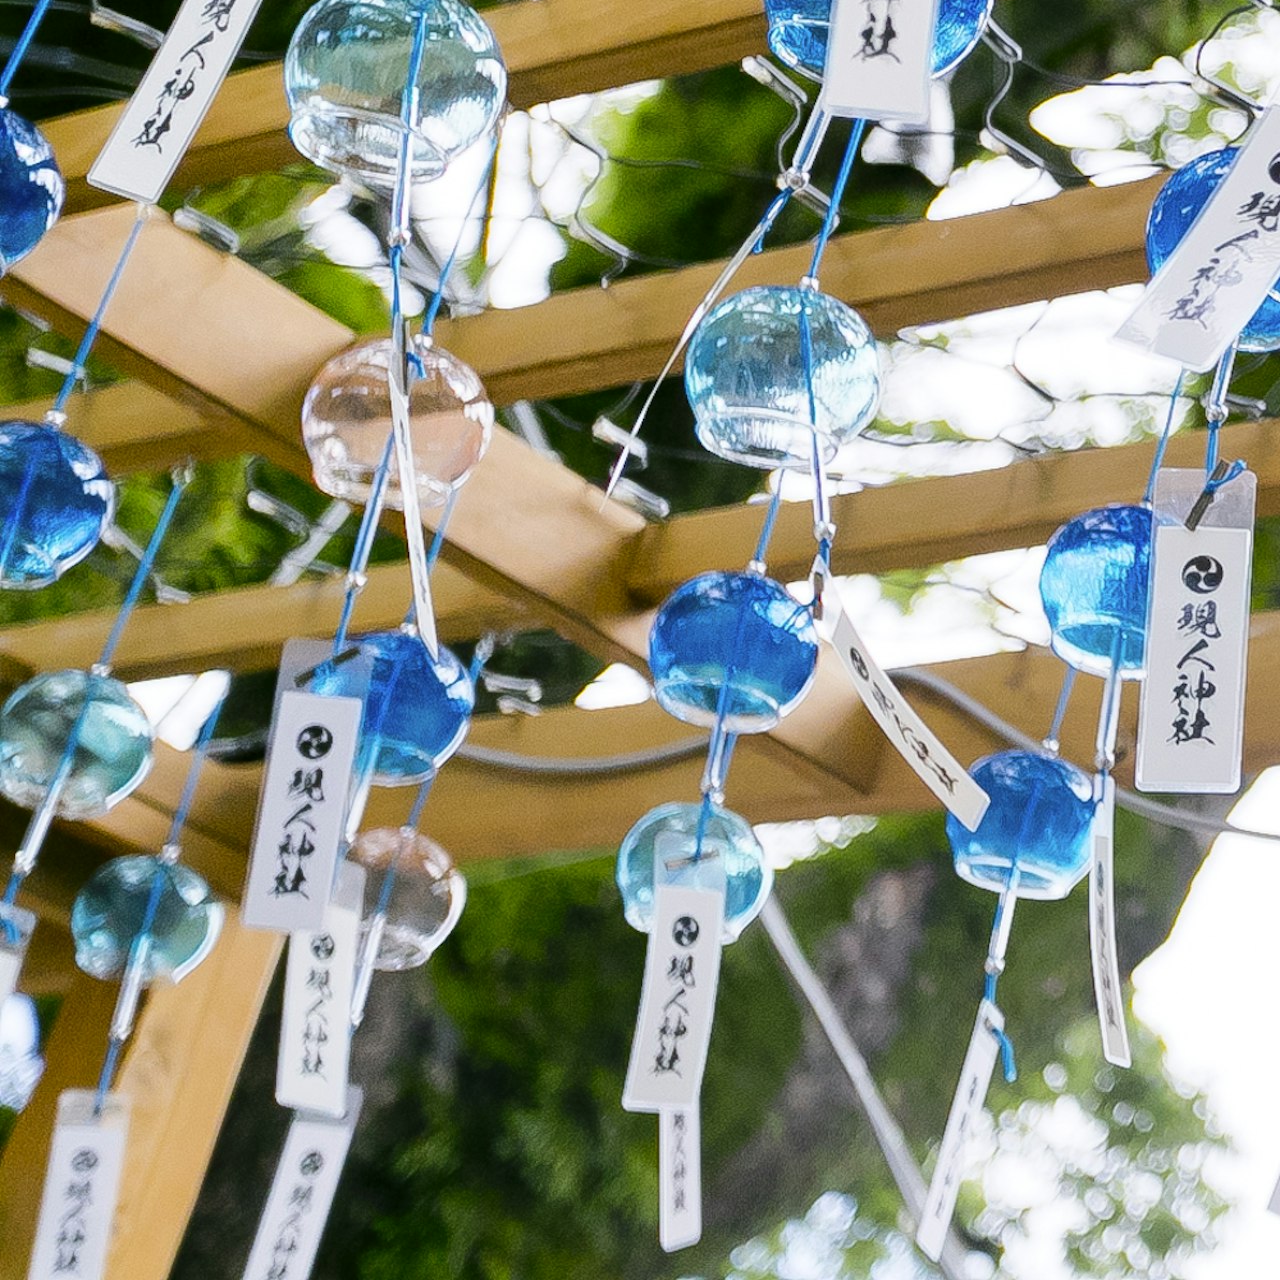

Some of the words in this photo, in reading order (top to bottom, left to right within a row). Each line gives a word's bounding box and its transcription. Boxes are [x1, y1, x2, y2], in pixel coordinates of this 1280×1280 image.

[1166, 599, 1223, 749] 現人神社
[269, 770, 327, 902] 現人神社
[300, 969, 330, 1081] 現人神社
[652, 956, 694, 1079] 現人神社
